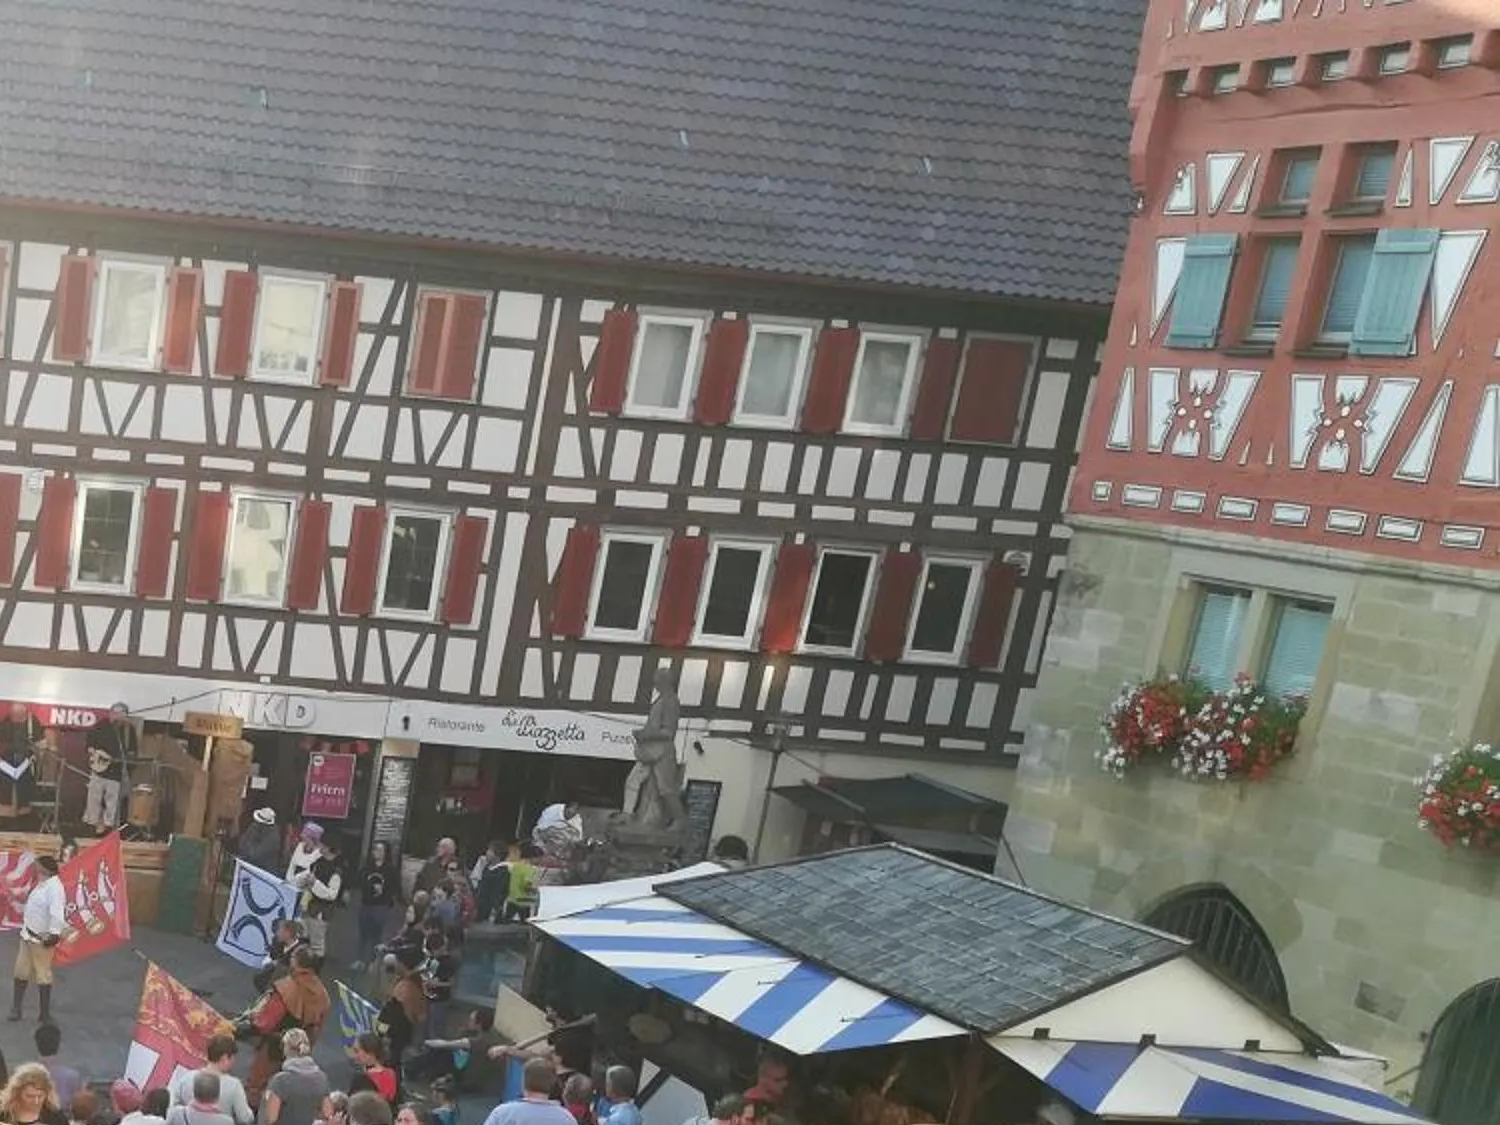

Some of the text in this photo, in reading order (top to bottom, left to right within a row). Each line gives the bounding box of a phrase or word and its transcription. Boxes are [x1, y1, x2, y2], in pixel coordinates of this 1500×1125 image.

[49, 707, 97, 727] NKD
[219, 689, 318, 729] NKD
[427, 717, 486, 733] Ristorante
[601, 730, 637, 746] Pizze
